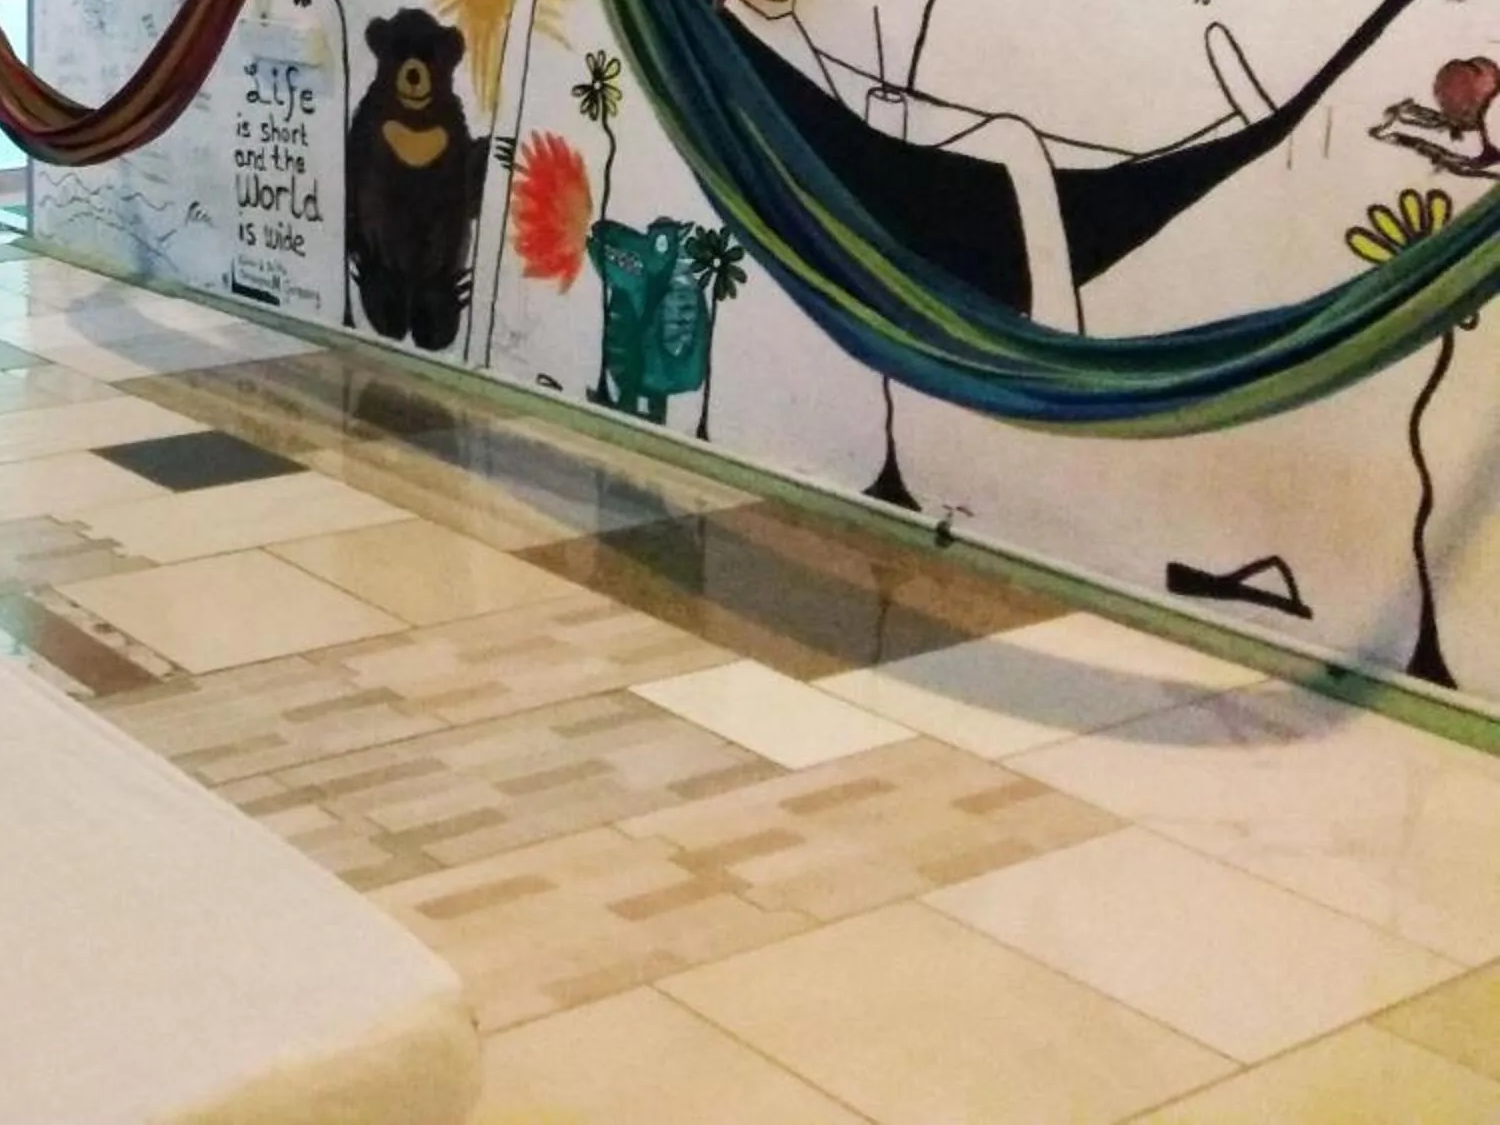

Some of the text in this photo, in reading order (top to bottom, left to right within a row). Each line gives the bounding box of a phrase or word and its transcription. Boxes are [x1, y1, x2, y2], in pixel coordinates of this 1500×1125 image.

[244, 62, 315, 122] Life
[236, 112, 308, 147] is short
[235, 144, 306, 174] and the
[235, 174, 323, 222] World
[238, 211, 306, 258] is wide
